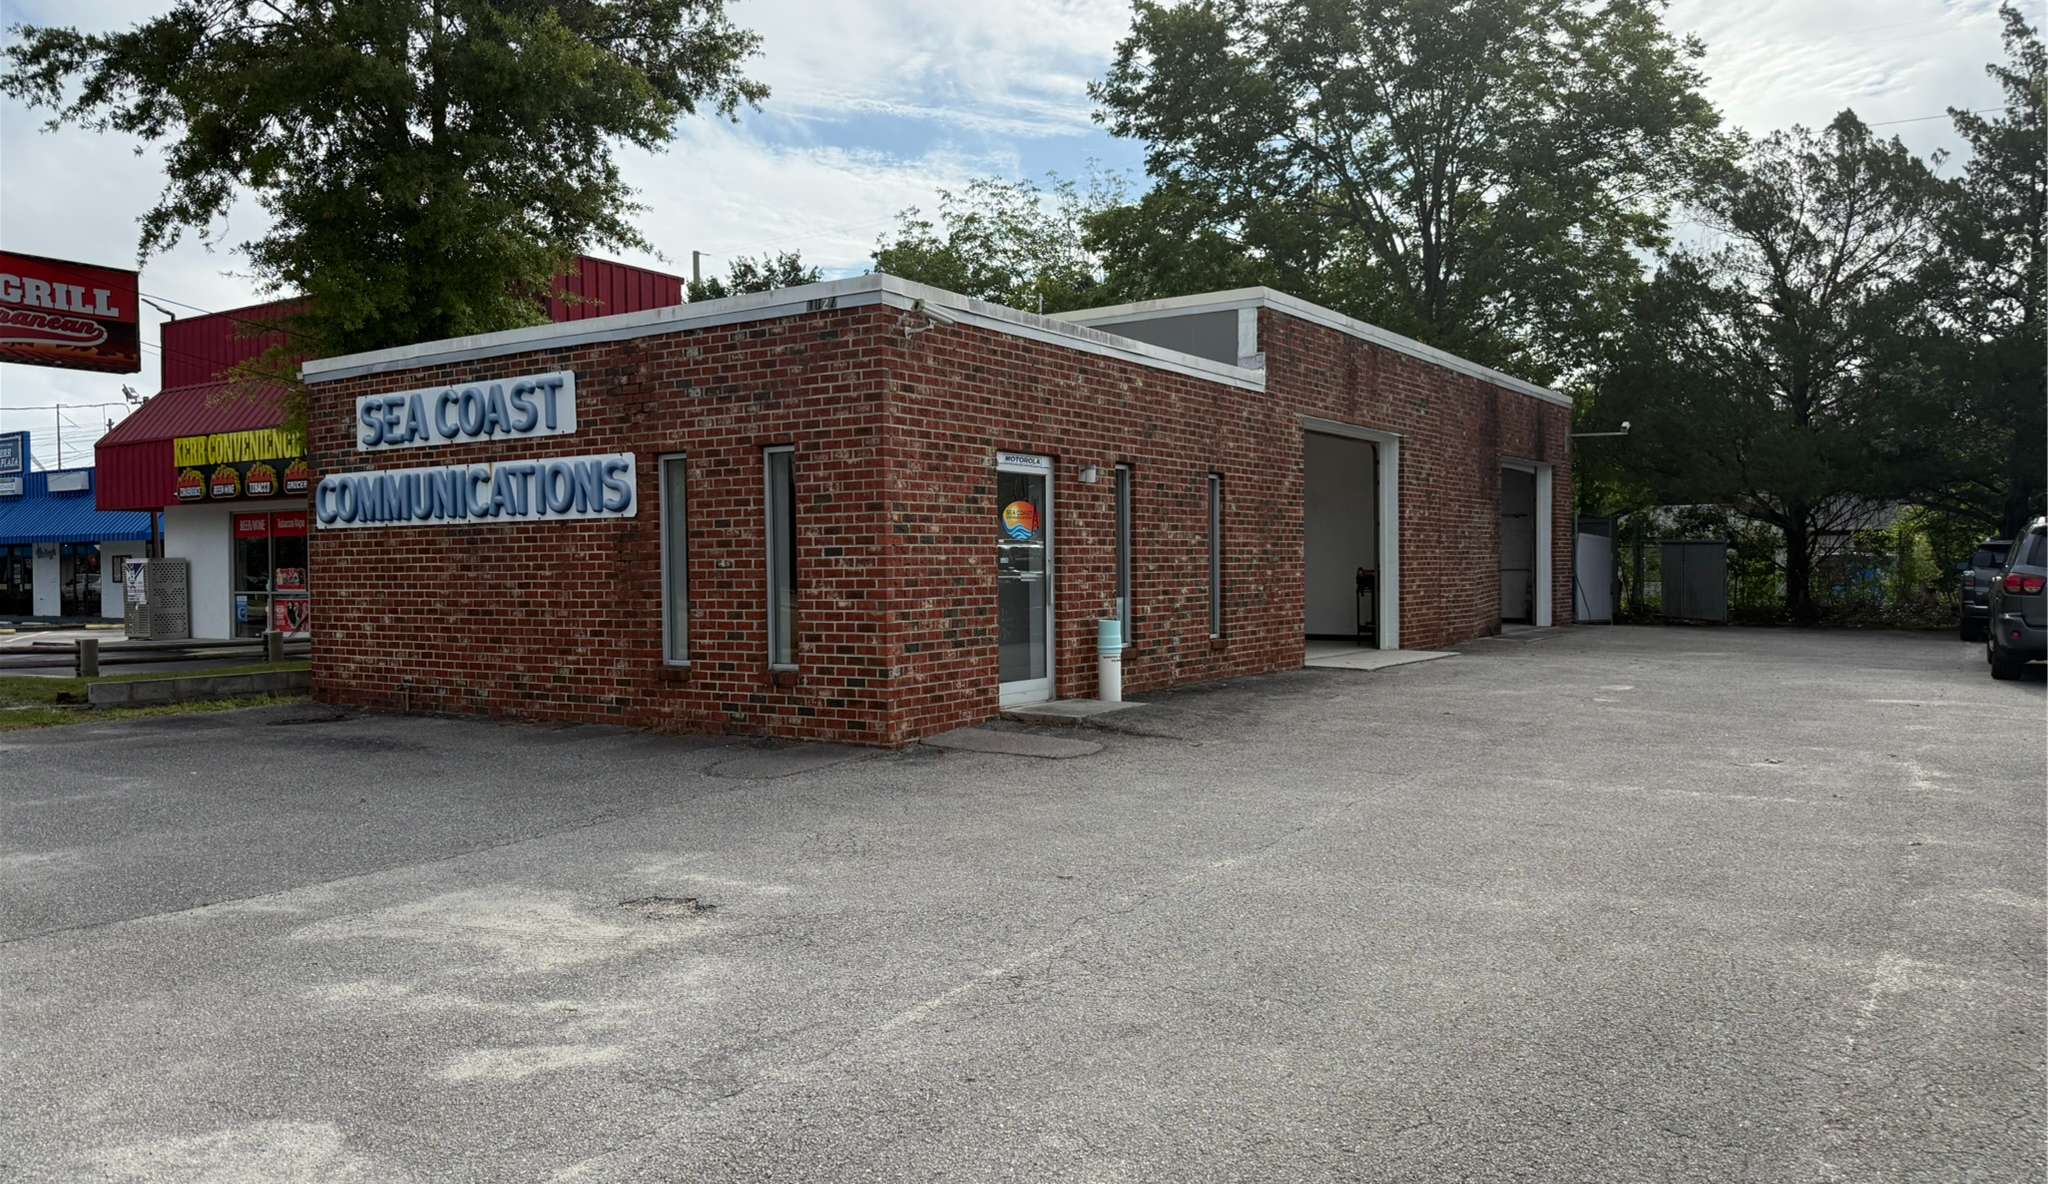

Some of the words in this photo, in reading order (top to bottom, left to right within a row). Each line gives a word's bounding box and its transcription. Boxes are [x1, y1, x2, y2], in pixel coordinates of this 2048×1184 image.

[0, 273, 119, 317] GRILL
[361, 393, 430, 446] SEA
[434, 376, 564, 439] COAST
[174, 436, 207, 467] KERR
[207, 428, 301, 465] CONVENIENCE
[1005, 455, 1040, 465] MOTOROLA
[248, 482, 271, 493] TOBACCO
[315, 458, 632, 524] COMMUNICATIONS
